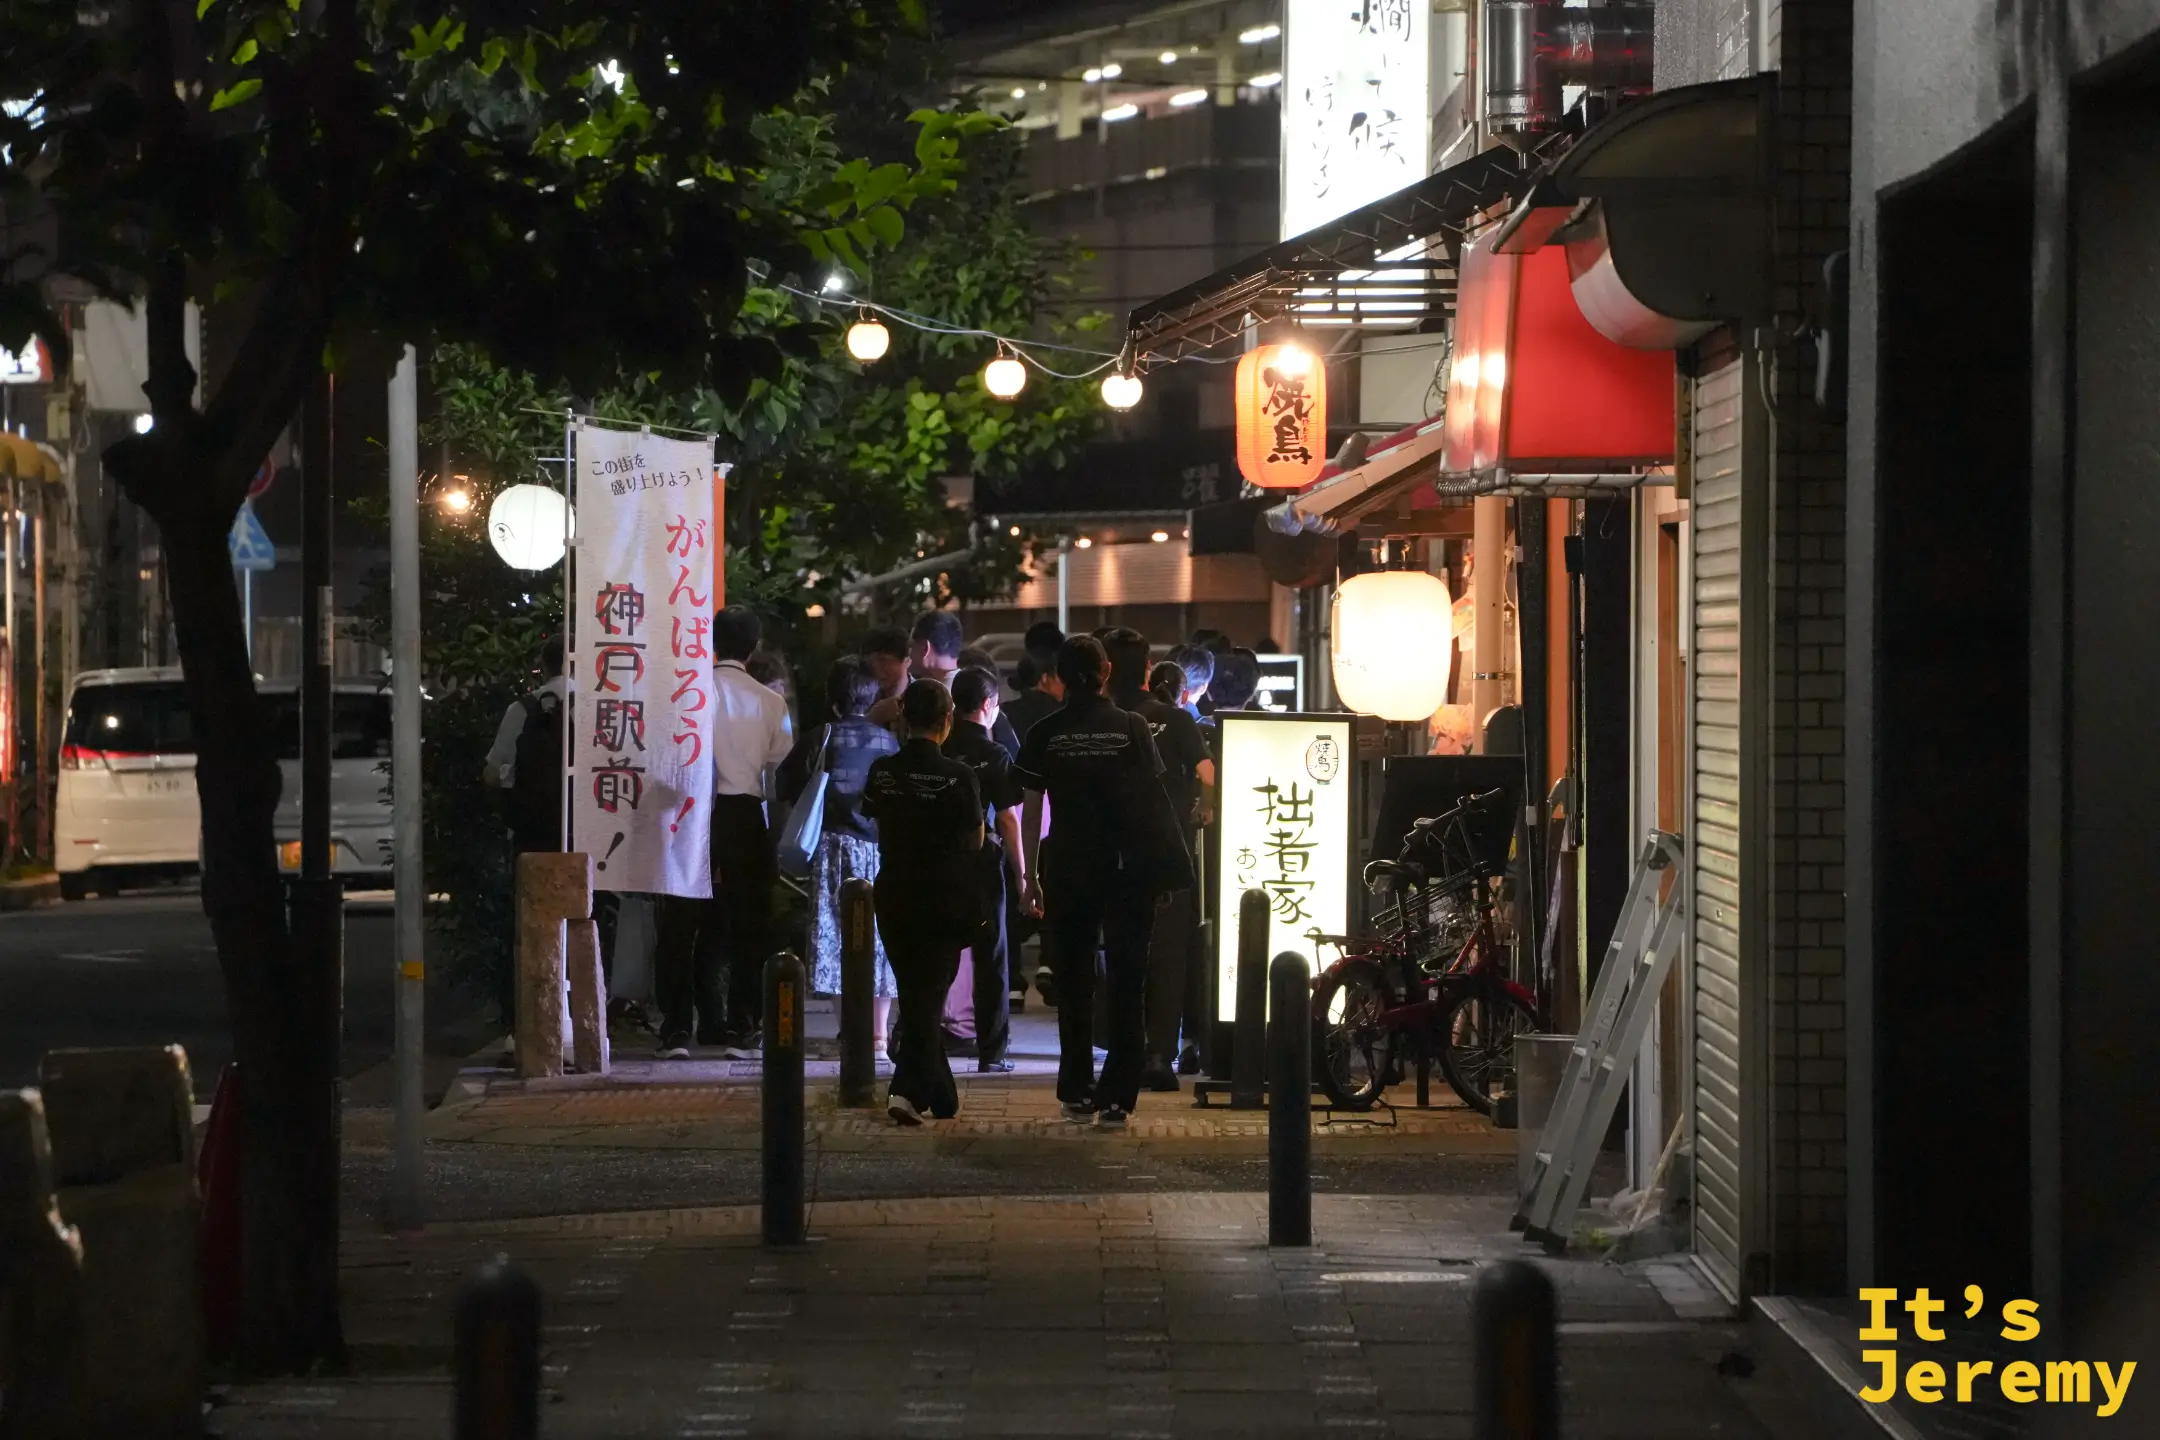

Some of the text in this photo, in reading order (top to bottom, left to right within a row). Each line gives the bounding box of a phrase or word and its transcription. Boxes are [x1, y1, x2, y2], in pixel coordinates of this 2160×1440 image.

[591, 452, 647, 477] この街を
[610, 467, 704, 497] 盛り上げよう！
[591, 580, 648, 873] 神戸駅前！
[665, 514, 710, 834] がんばろう！
[1252, 776, 1320, 925] 拙者家
